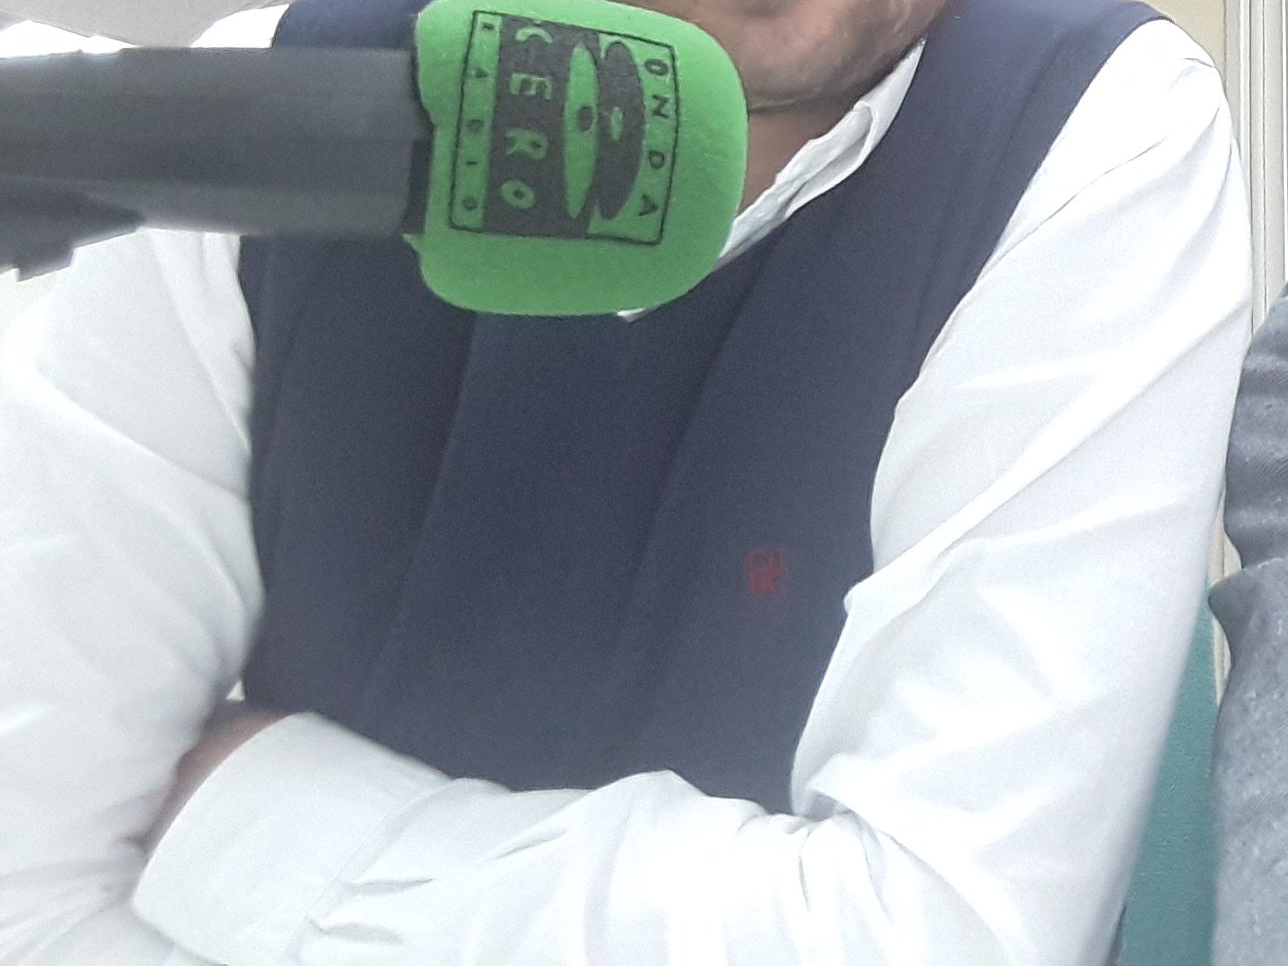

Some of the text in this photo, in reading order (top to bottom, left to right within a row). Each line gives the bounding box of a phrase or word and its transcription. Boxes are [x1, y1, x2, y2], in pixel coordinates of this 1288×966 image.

[463, 21, 496, 211] RADIO
[500, 25, 553, 210] CERO
[638, 57, 669, 217] ONDA
